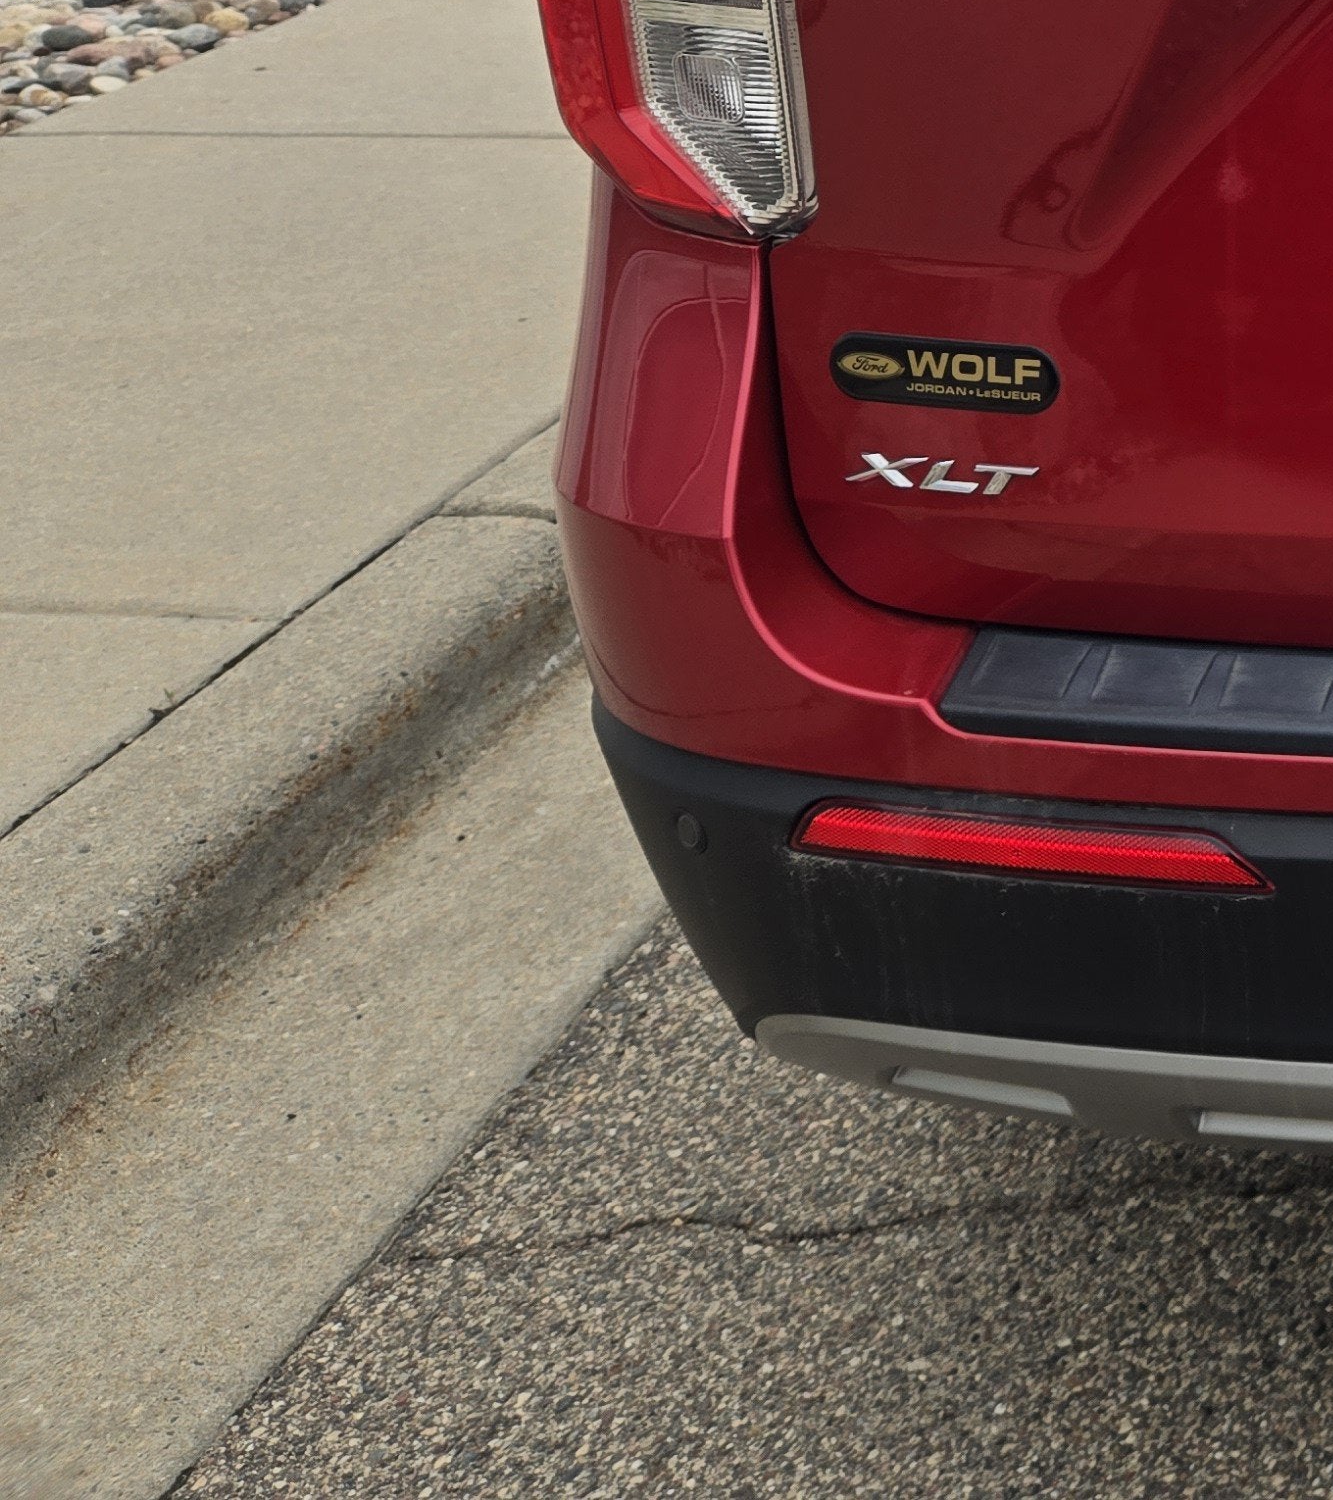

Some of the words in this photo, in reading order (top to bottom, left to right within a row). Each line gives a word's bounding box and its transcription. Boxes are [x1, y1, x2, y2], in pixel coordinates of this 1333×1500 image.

[851, 355, 890, 374] Ford
[906, 349, 1042, 385] WOLF
[844, 451, 1041, 496] XLT
